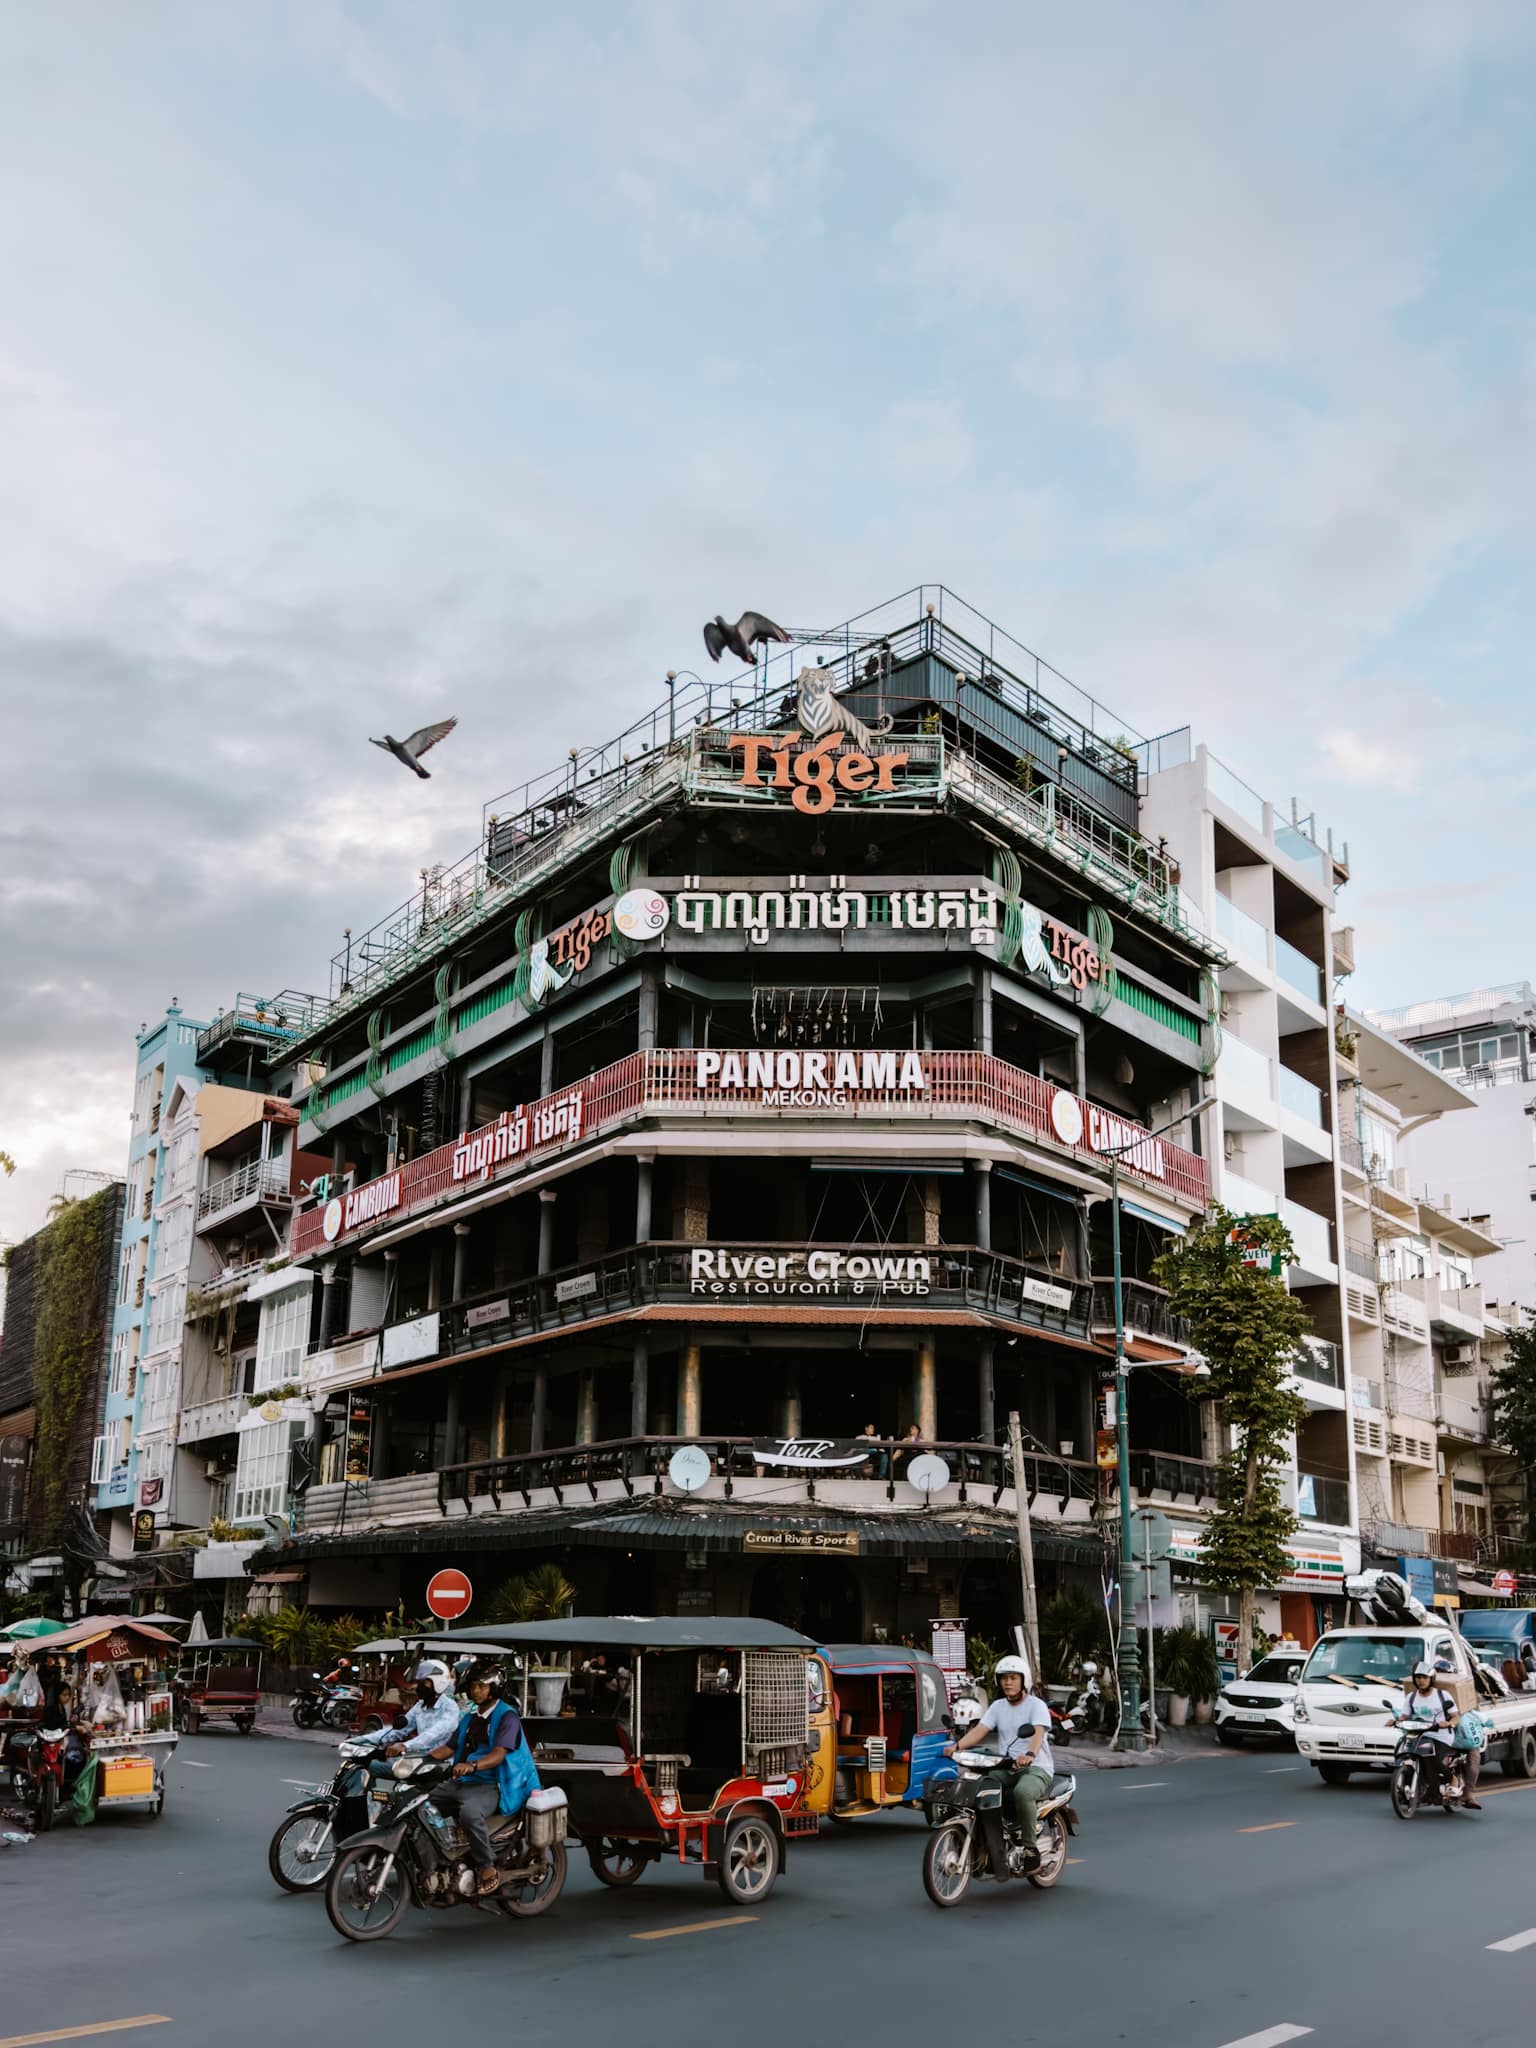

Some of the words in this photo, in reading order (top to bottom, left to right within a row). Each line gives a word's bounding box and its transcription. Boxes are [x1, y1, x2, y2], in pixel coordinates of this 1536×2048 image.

[727, 731, 910, 815] Tiger
[696, 1051, 925, 1089] PANORAMA
[762, 1090, 847, 1107] MEKONG
[1089, 1107, 1165, 1180] CAMBODIA
[345, 1172, 401, 1230] CAMBODIA
[690, 1248, 793, 1280] River
[807, 1250, 930, 1281] Crown
[690, 1280, 841, 1295] Restaurant
[852, 1280, 866, 1295] &
[882, 1280, 930, 1295] Pub
[746, 1531, 782, 1544] Grand
[784, 1533, 813, 1545] River
[815, 1533, 857, 1546] Sports
